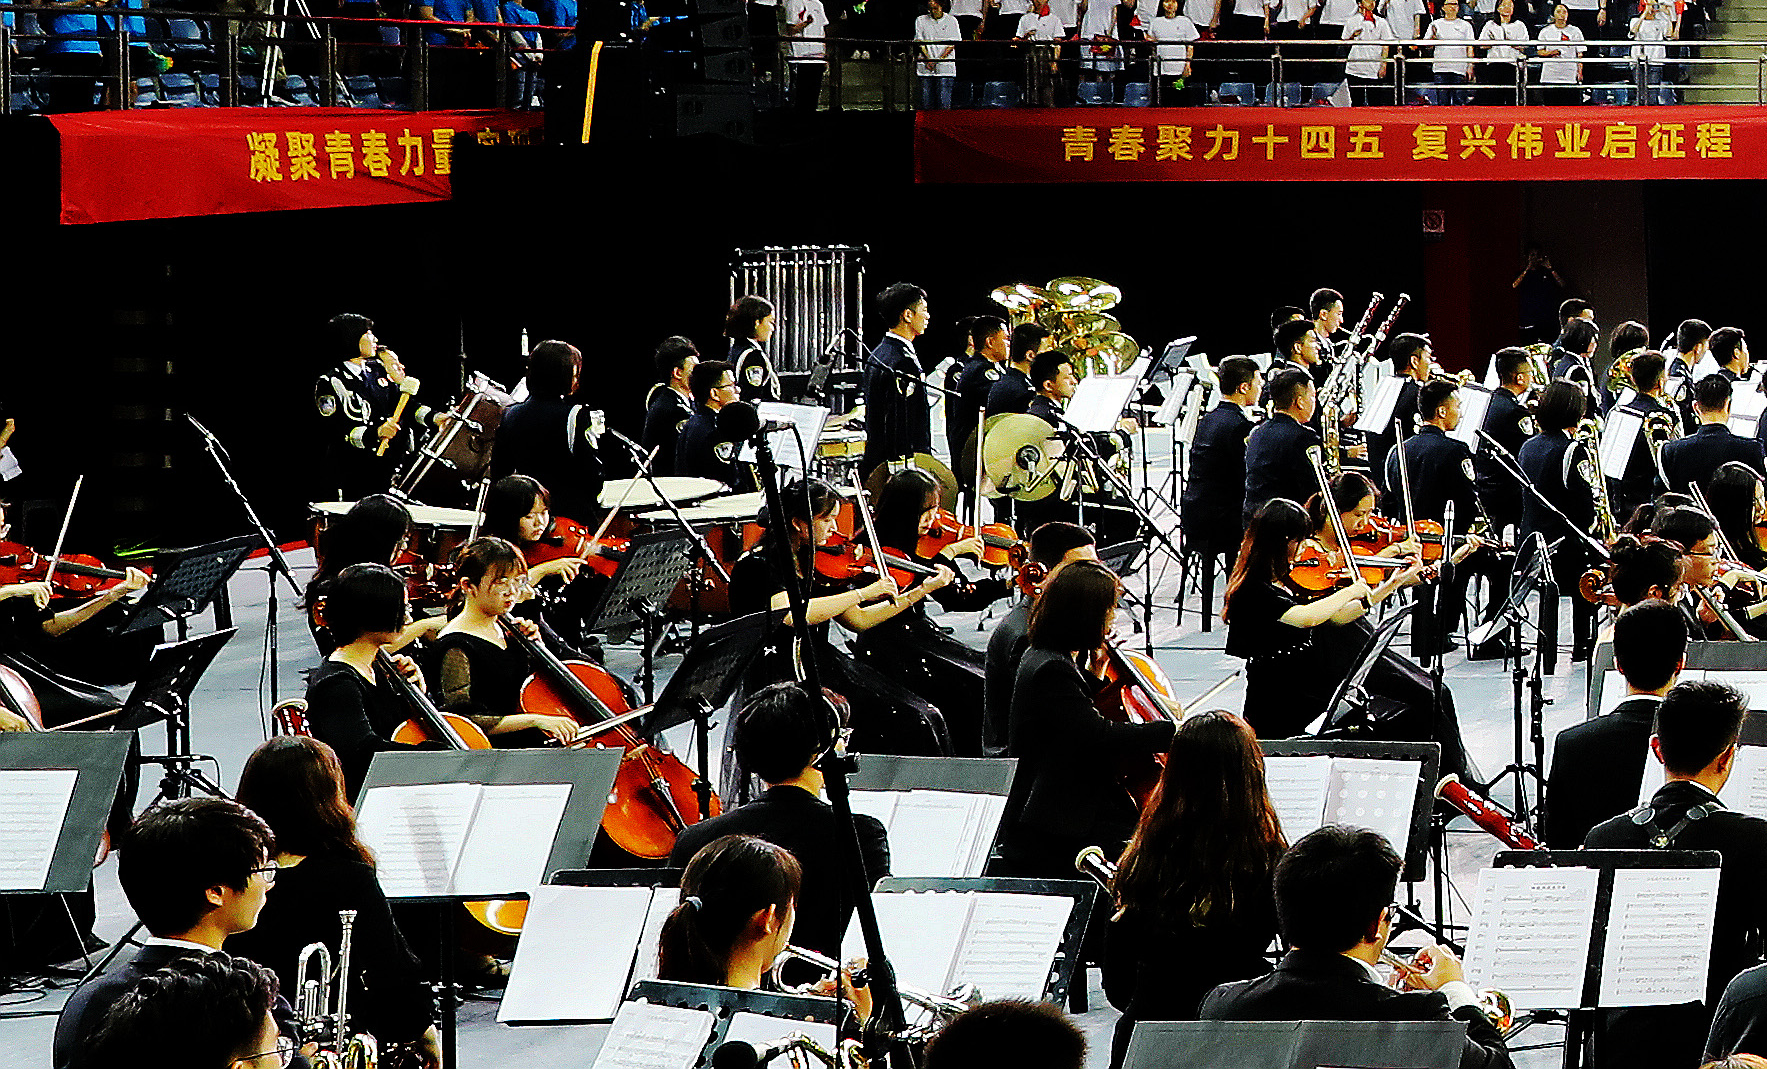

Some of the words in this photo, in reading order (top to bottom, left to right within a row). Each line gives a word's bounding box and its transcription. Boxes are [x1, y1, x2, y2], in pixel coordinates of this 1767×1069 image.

[246, 128, 455, 182] 凝聚青春力量
[1062, 122, 1385, 162] 青春聚力十四五
[1412, 121, 1734, 161] 复兴伟业启征程
